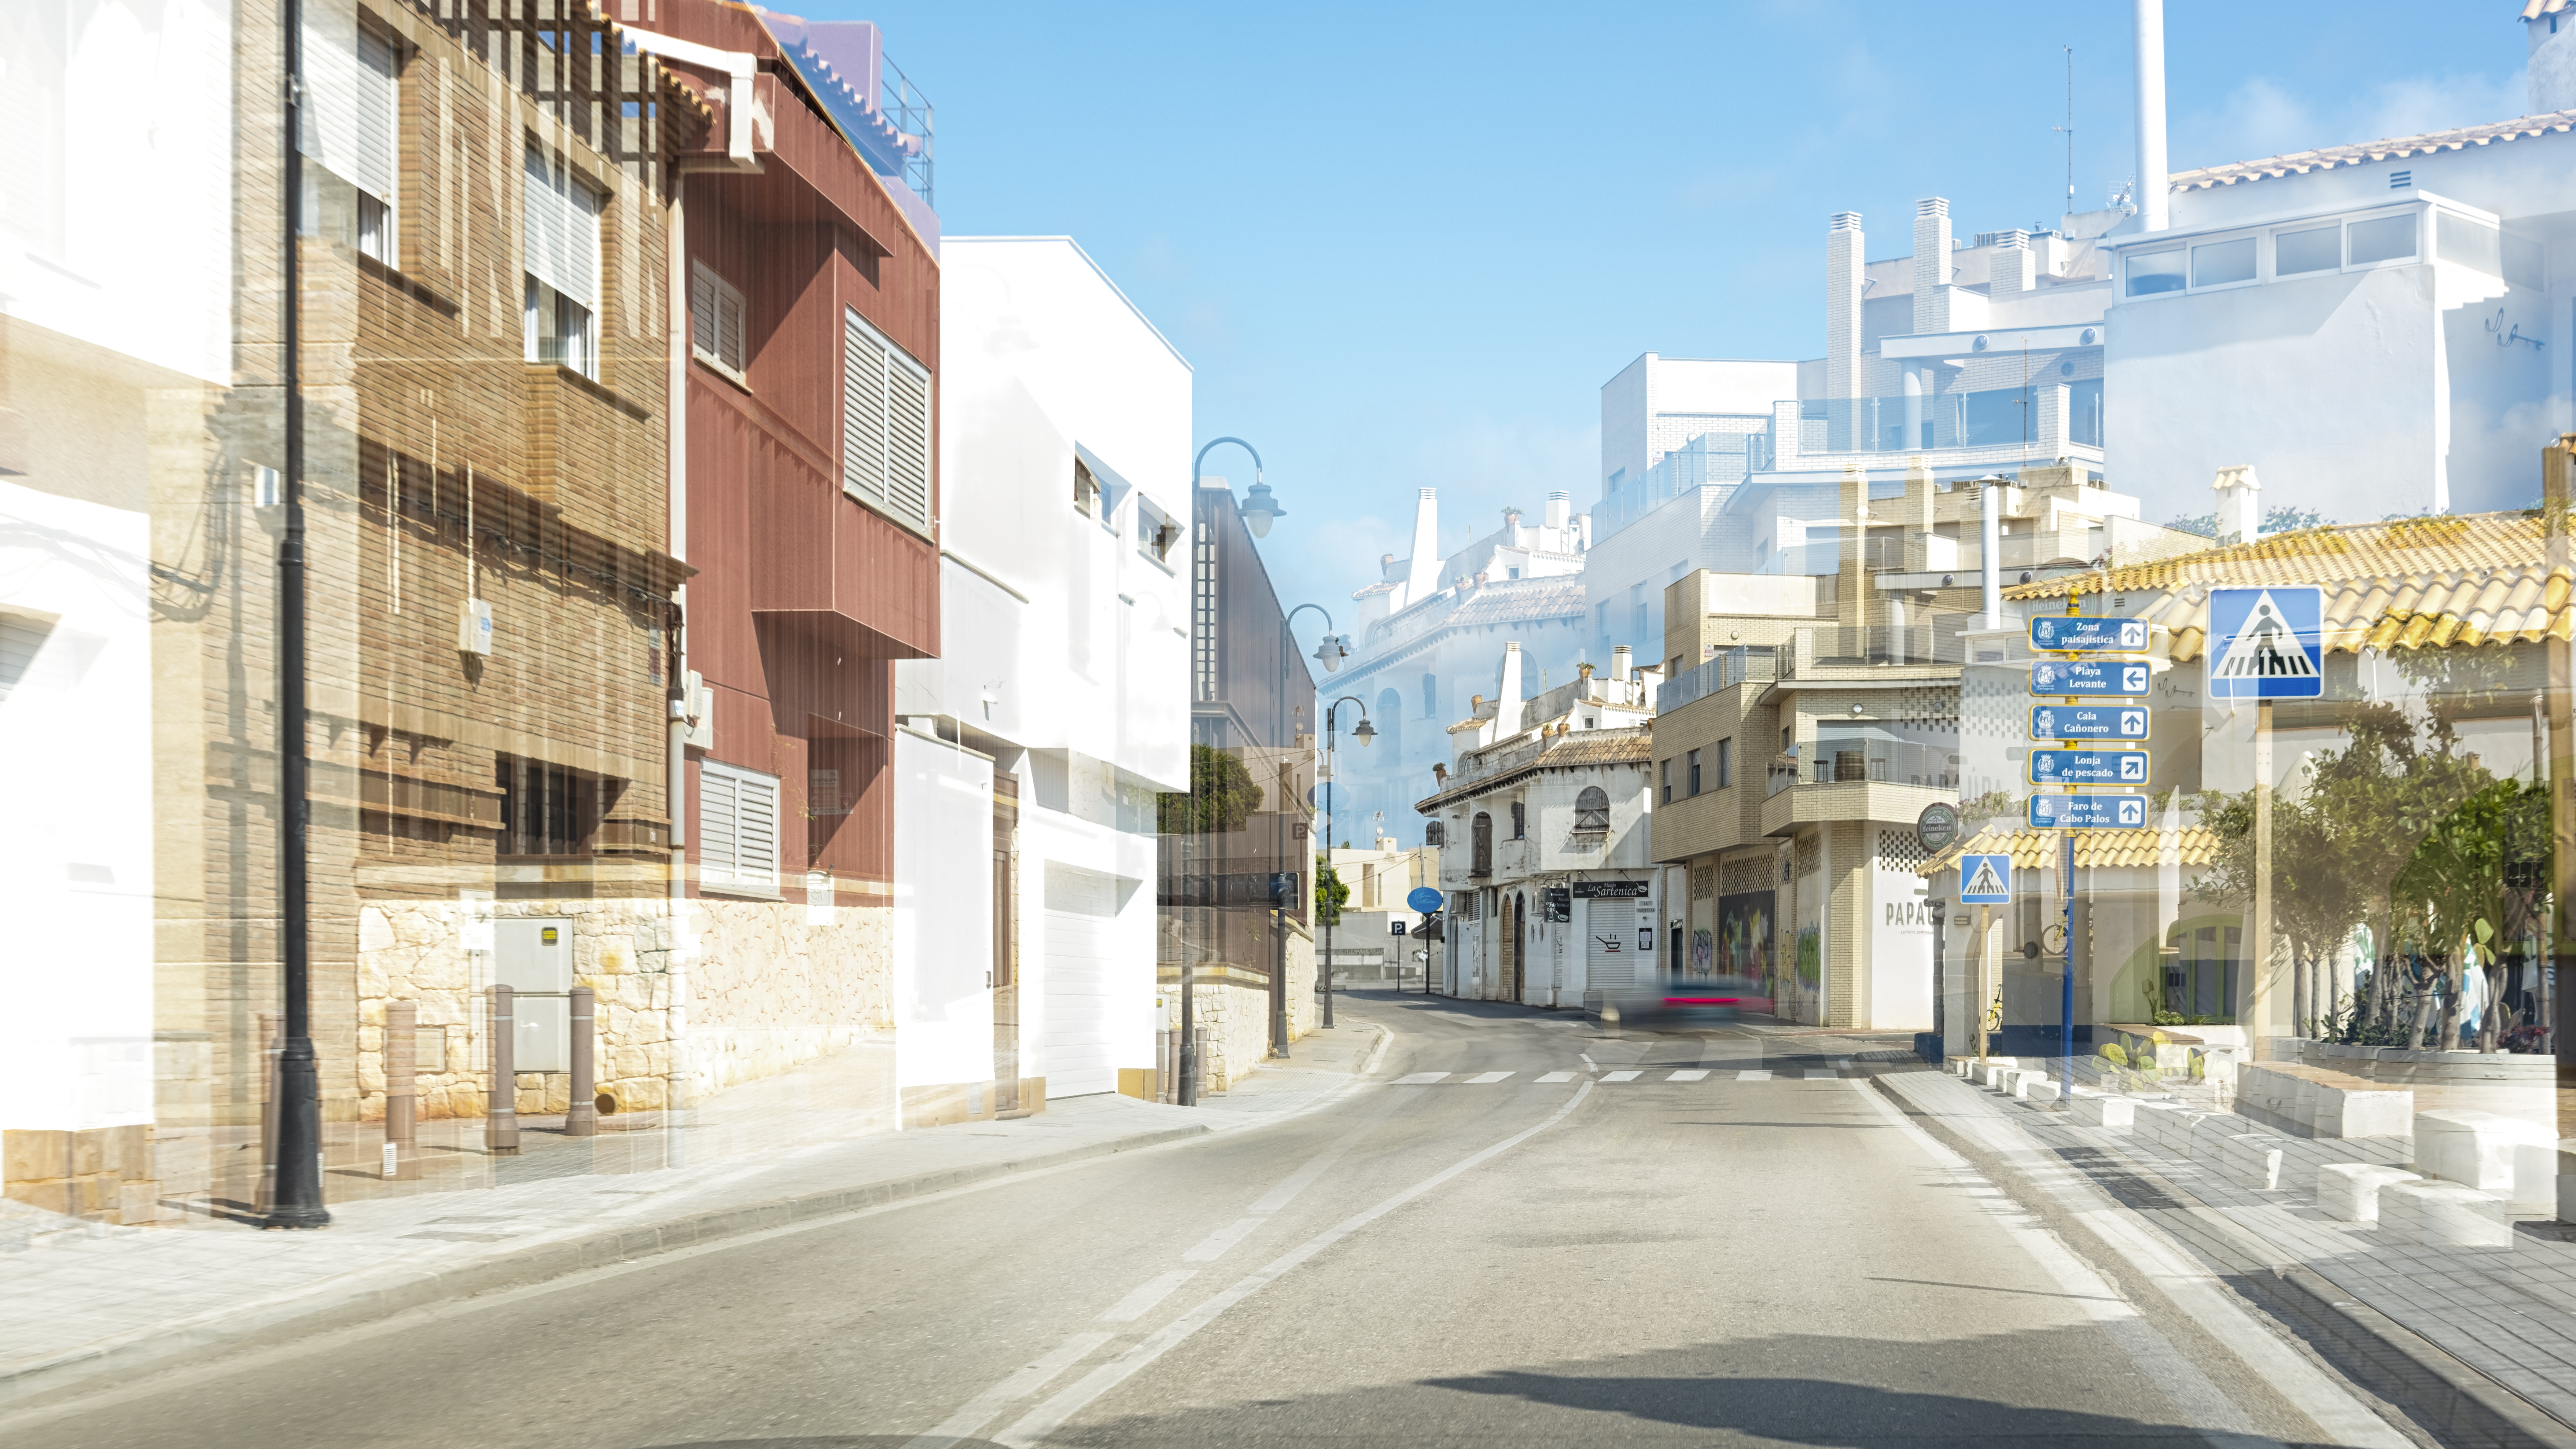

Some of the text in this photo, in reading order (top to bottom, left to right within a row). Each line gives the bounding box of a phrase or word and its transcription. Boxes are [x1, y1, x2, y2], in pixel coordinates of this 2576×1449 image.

[2076, 622, 2099, 631] Zona
[2075, 666, 2101, 677] Playa
[2069, 679, 2106, 688] Levante
[2077, 711, 2097, 720] Cala
[2064, 724, 2109, 733] Cañonero
[2075, 755, 2101, 766] Lonja
[2062, 768, 2113, 779] de pescado
[2068, 802, 2103, 810] Faro de
[2060, 814, 2110, 823] Cabo Palos
[1922, 824, 1951, 832] Heineken
[1594, 886, 1638, 897] Sartenica
[1394, 923, 1403, 934] P
